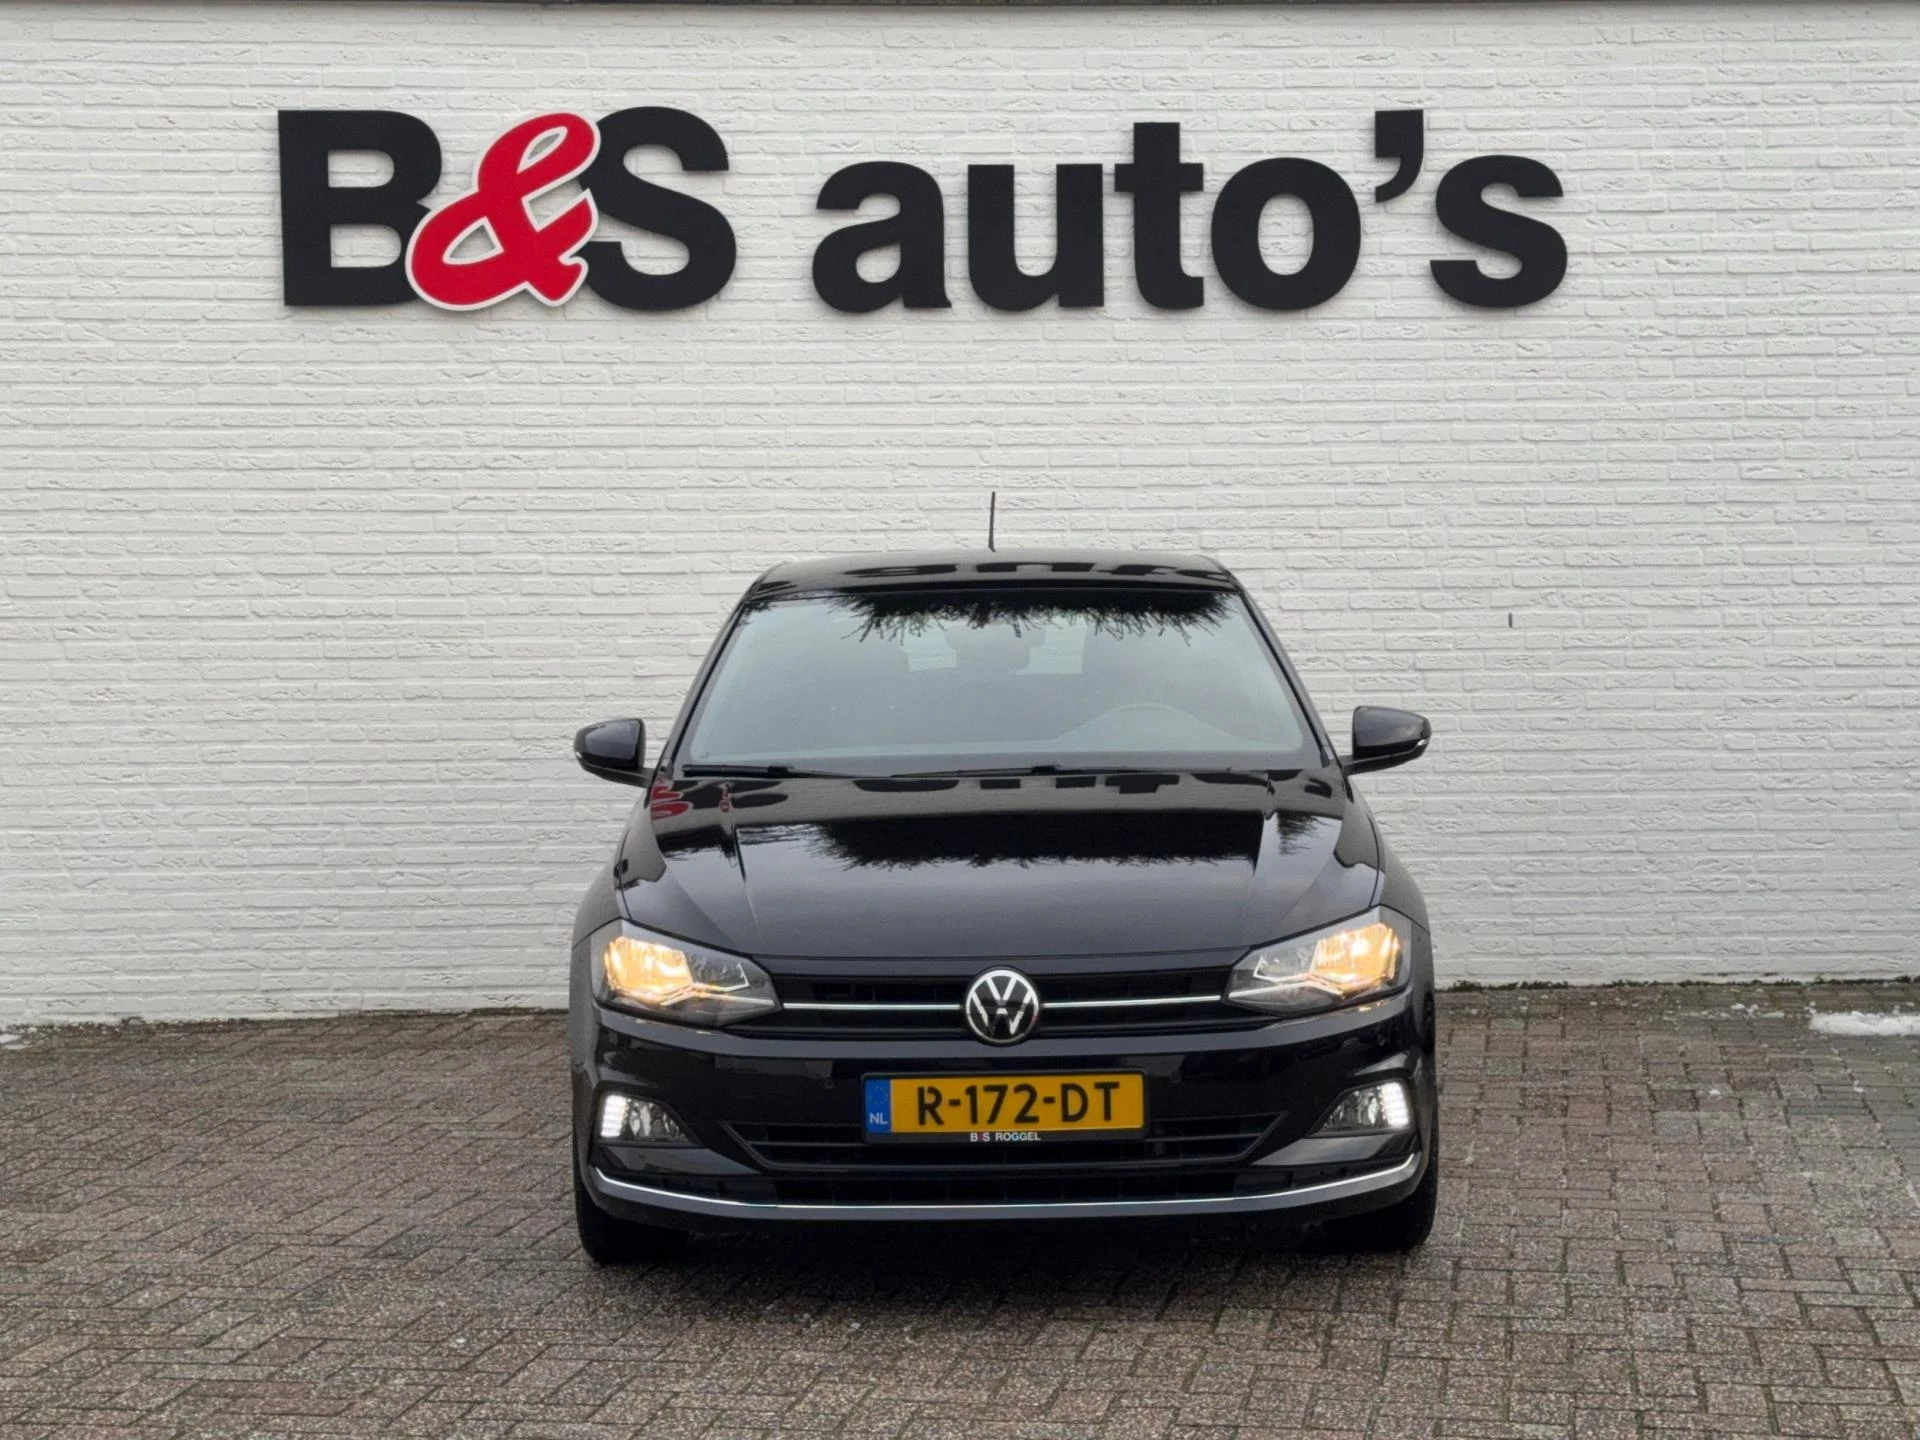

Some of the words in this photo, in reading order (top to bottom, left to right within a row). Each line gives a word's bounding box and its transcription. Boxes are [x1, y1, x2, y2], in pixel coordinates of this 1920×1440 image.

[278, 106, 737, 312] B&S
[812, 109, 1568, 314] auto's
[869, 1111, 889, 1125] NL
[917, 1081, 1120, 1126] R-172-DT
[995, 1131, 1041, 1142] ROGGEL
